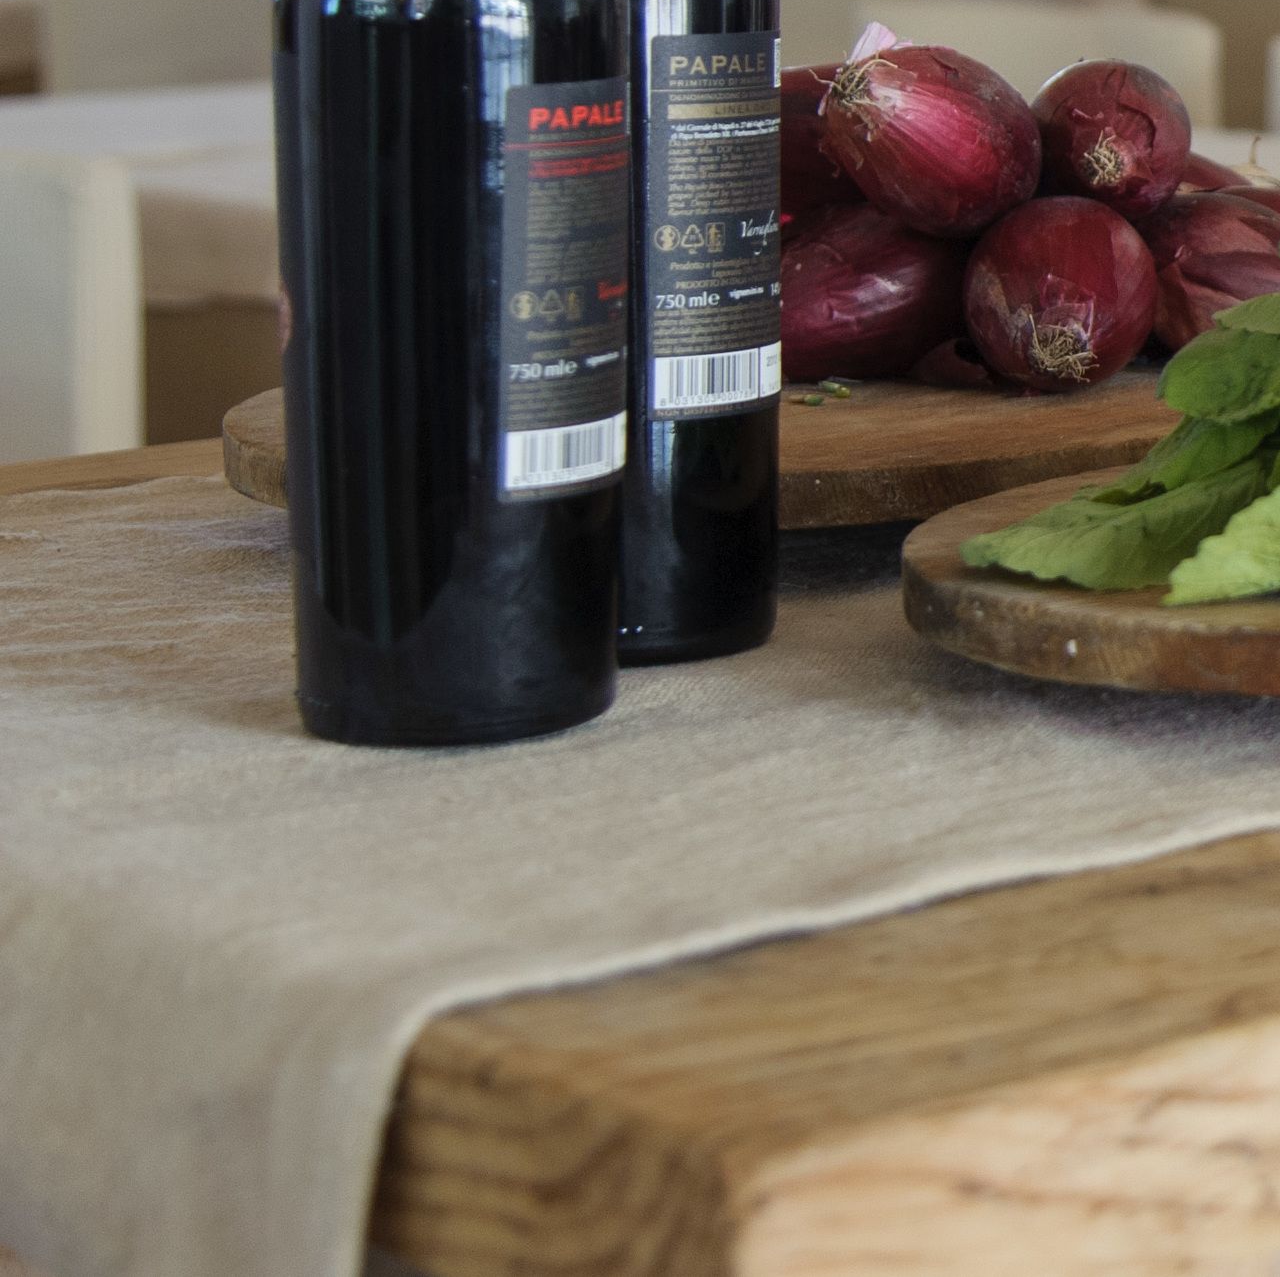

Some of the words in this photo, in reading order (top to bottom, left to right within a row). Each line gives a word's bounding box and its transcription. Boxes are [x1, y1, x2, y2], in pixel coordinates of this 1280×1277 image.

[669, 52, 767, 76] PAPALE
[669, 78, 725, 88] PRIMITIVO
[528, 100, 624, 131] PAPALE
[655, 293, 687, 309] 750
[509, 362, 542, 380] 750
